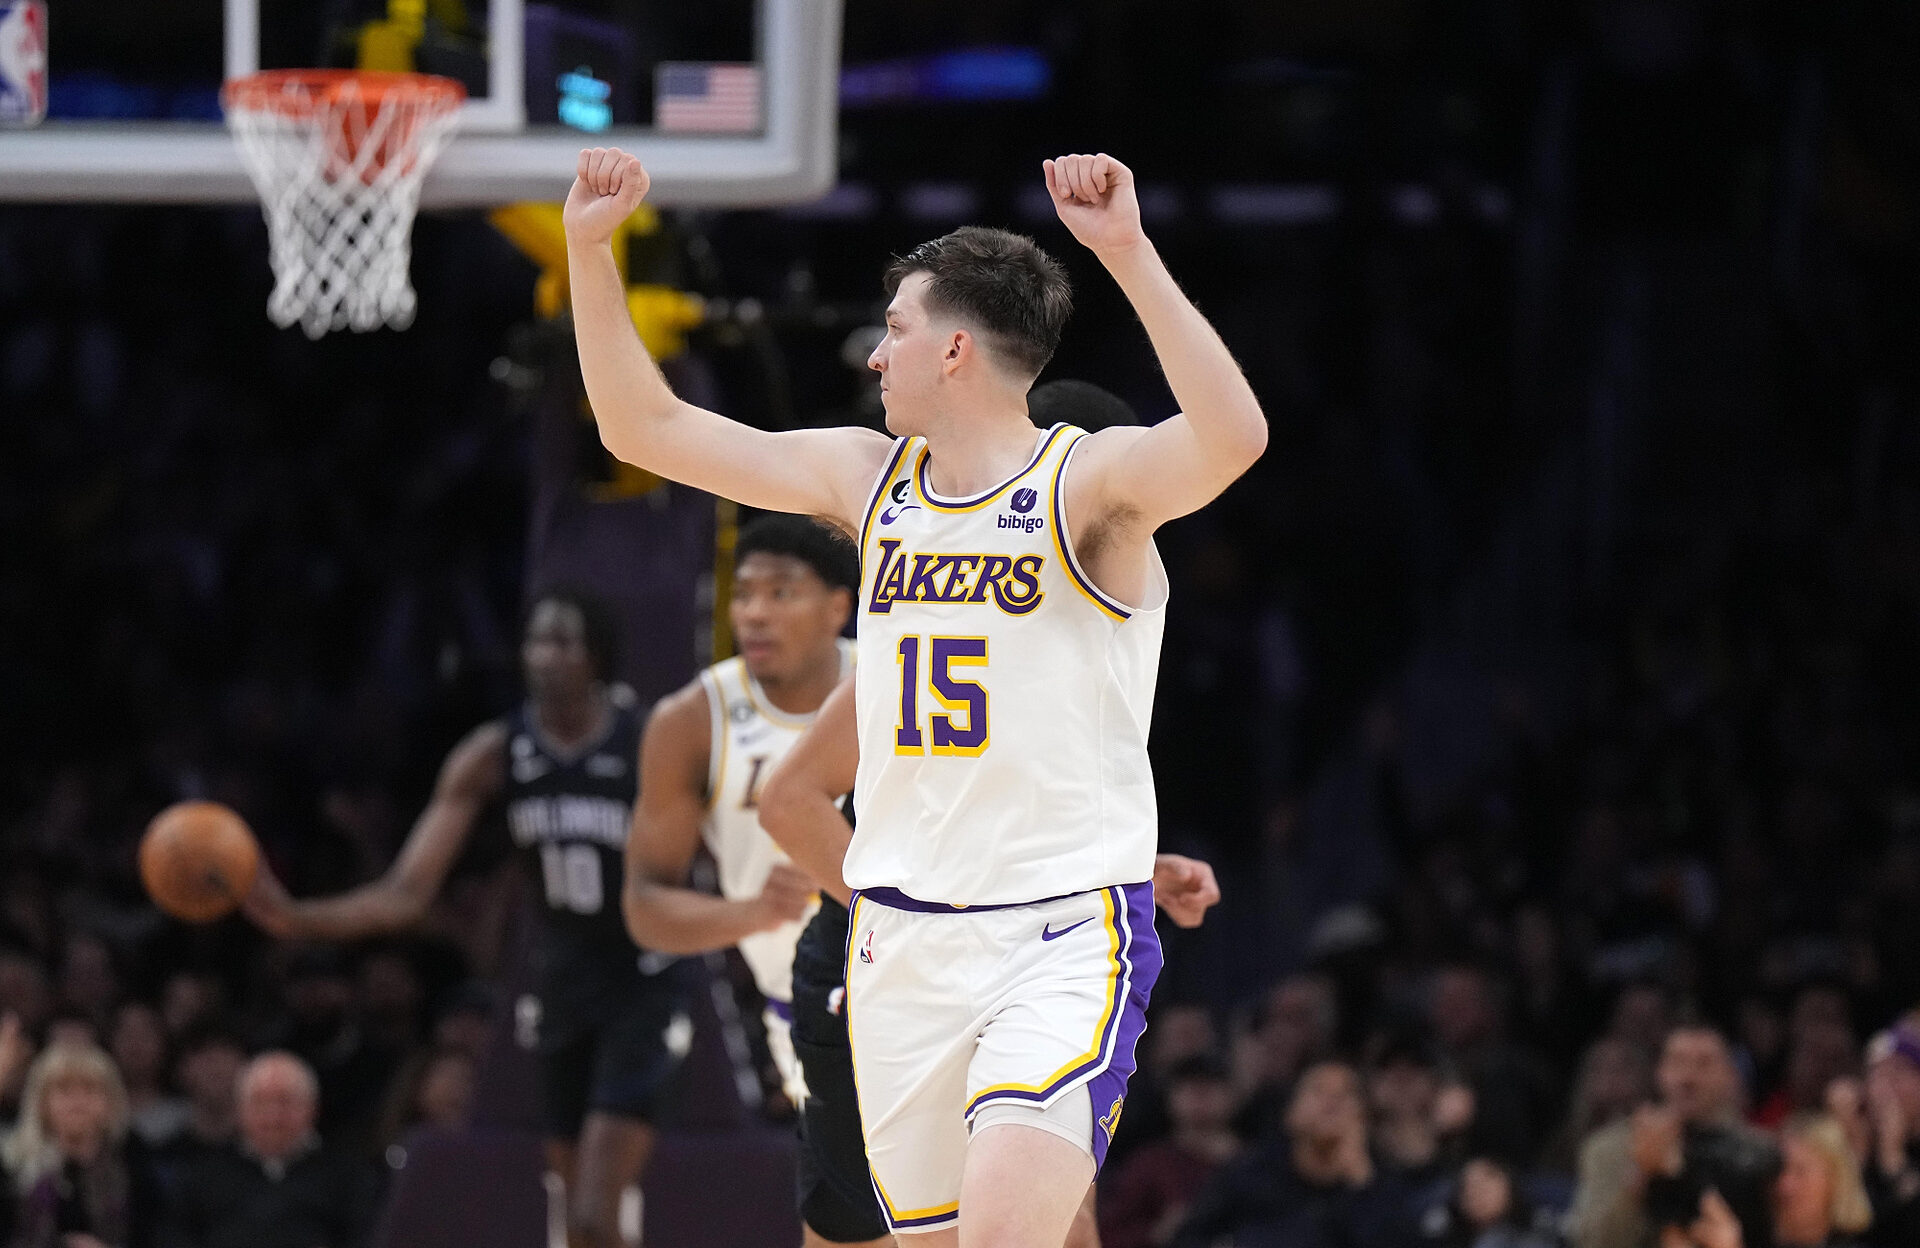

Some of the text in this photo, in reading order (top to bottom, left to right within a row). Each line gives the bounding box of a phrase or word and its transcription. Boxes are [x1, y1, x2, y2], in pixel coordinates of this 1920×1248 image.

[997, 514, 1043, 533] bibigo
[868, 537, 1046, 616] LAKERS
[895, 634, 990, 757] 15
